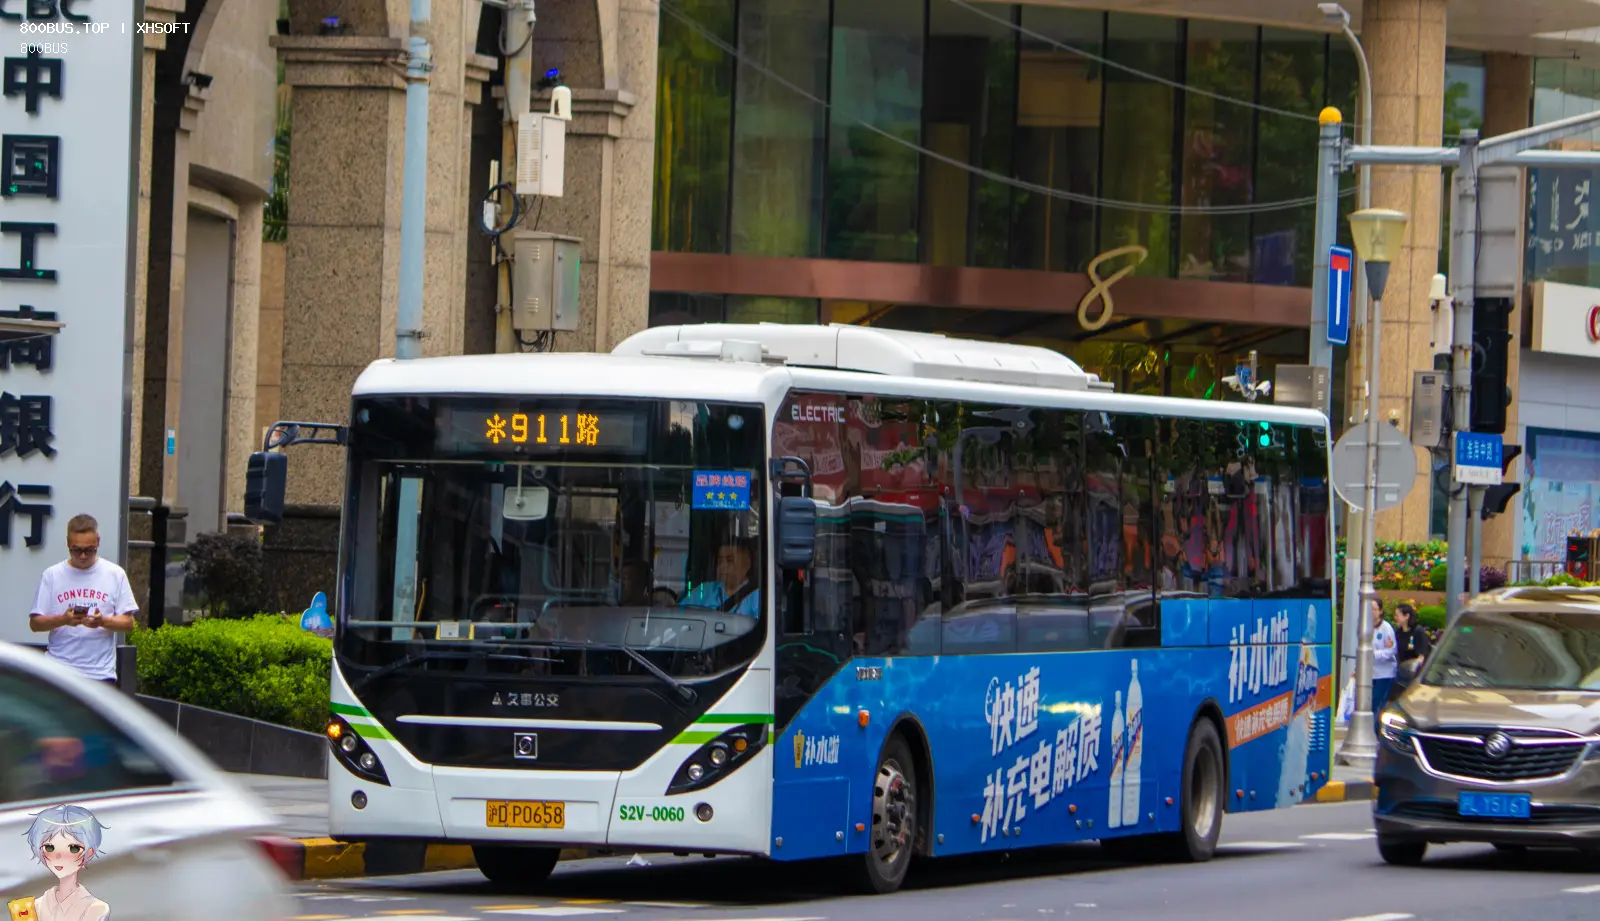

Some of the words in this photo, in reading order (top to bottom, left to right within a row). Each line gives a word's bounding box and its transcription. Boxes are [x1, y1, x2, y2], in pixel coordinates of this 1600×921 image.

[791, 404, 846, 423] ELECTRIC
[57, 588, 109, 603] CONVERSE
[507, 692, 559, 707] 久事公交
[985, 666, 1041, 757] 快速
[980, 704, 1103, 844] 补充电解质
[619, 804, 685, 823] S2V-0060
